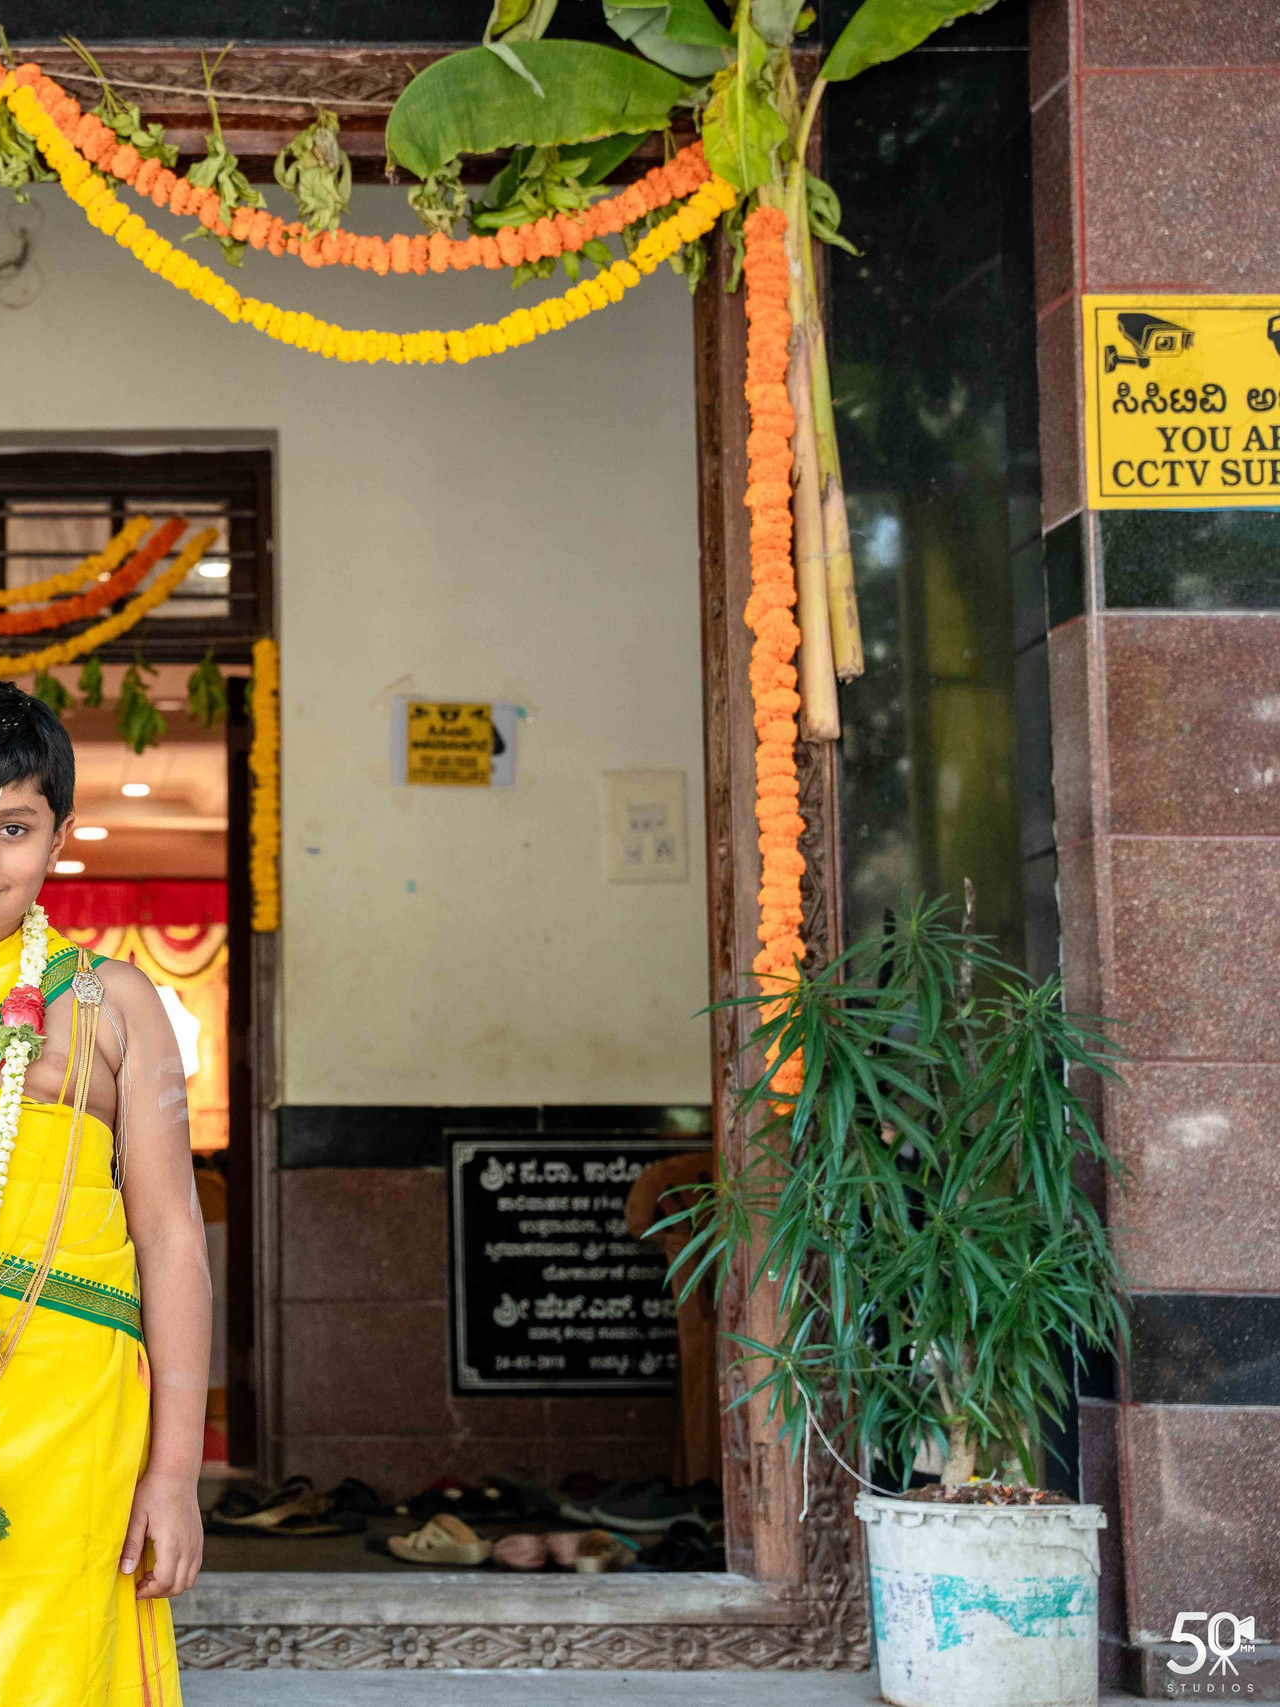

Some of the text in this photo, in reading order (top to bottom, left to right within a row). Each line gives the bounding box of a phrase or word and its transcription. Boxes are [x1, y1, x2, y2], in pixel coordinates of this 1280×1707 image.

[1112, 382, 1280, 414] ಸಿಸಿಟಿವಿ ಅ
[1157, 425, 1231, 452] YOU
[1112, 460, 1210, 487] CCTV
